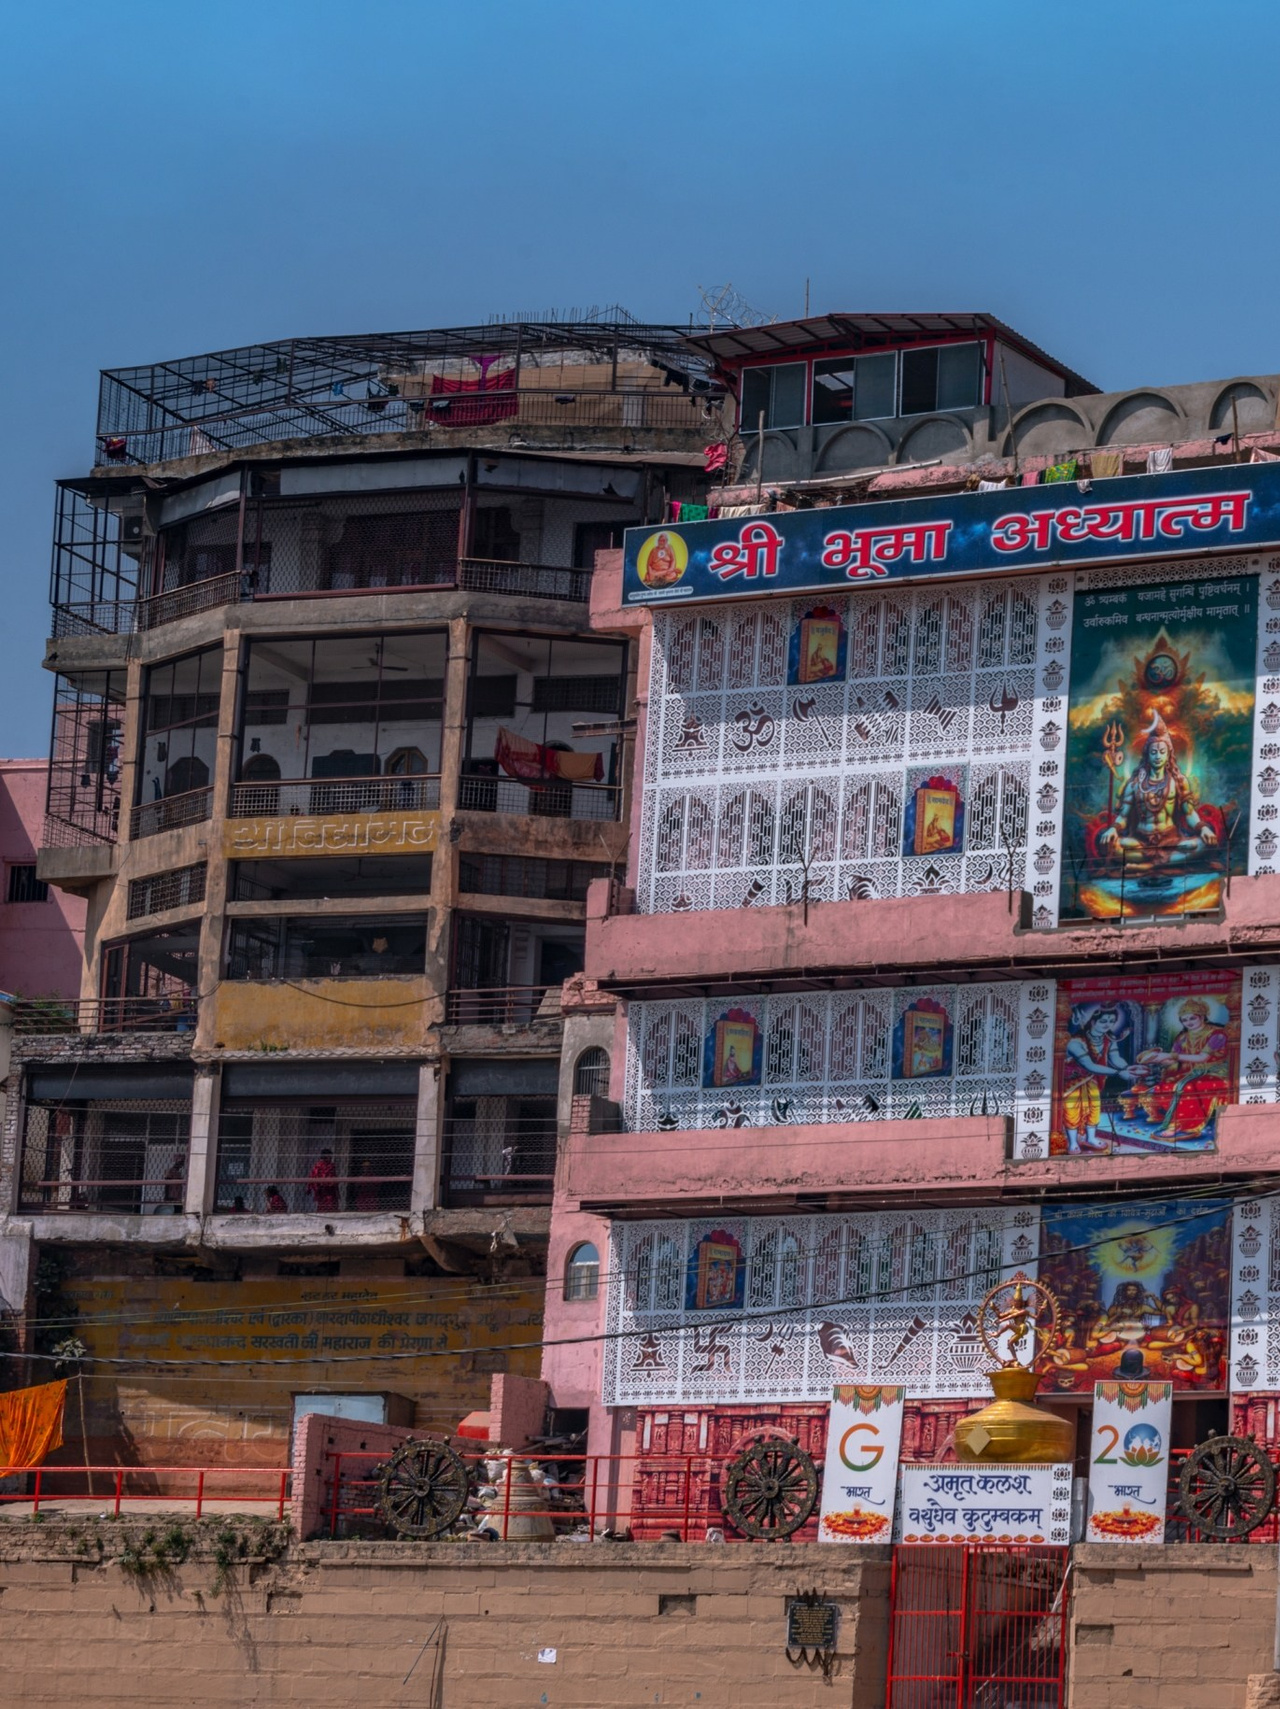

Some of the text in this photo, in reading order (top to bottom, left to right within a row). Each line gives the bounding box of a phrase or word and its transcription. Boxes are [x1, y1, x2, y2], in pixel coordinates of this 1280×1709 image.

[709, 521, 784, 581] श्री
[822, 521, 952, 579] भूमा
[992, 491, 1251, 552] अध्यात्म
[1137, 587, 1167, 601] यजामहे
[322, 1336, 371, 1350] महाराज
[839, 1423, 884, 1472] G
[841, 1486, 886, 1504] भारत
[923, 1474, 1032, 1501] अमृत कलश
[1108, 1484, 1156, 1504] भारत
[961, 1508, 1043, 1532] कुटुम्बकम्
